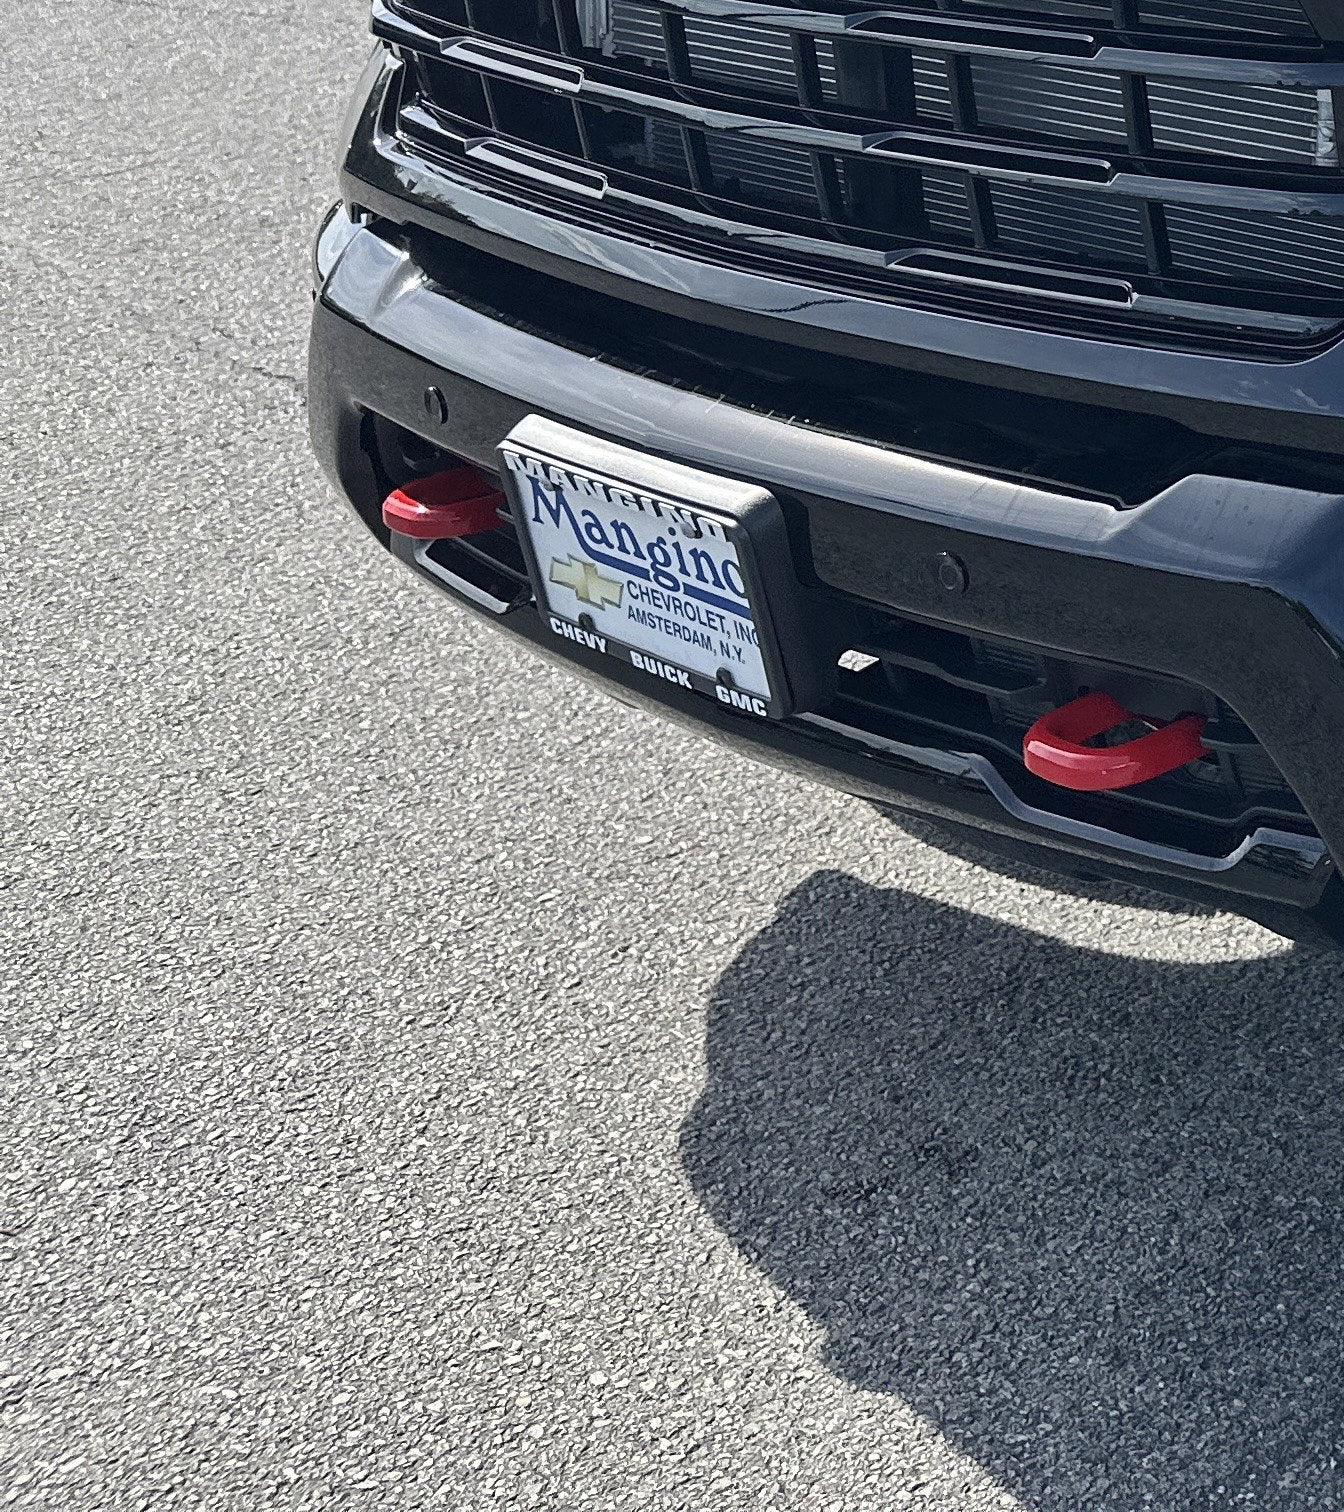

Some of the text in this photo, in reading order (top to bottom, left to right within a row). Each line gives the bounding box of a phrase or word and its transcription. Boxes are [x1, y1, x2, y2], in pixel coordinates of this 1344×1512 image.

[531, 474, 747, 599] Mangino
[627, 580, 731, 639] CHEVROLET,
[627, 606, 746, 664] AMSTERDAM, N.Y.
[550, 617, 768, 717] CHEVY BUICK GMC
